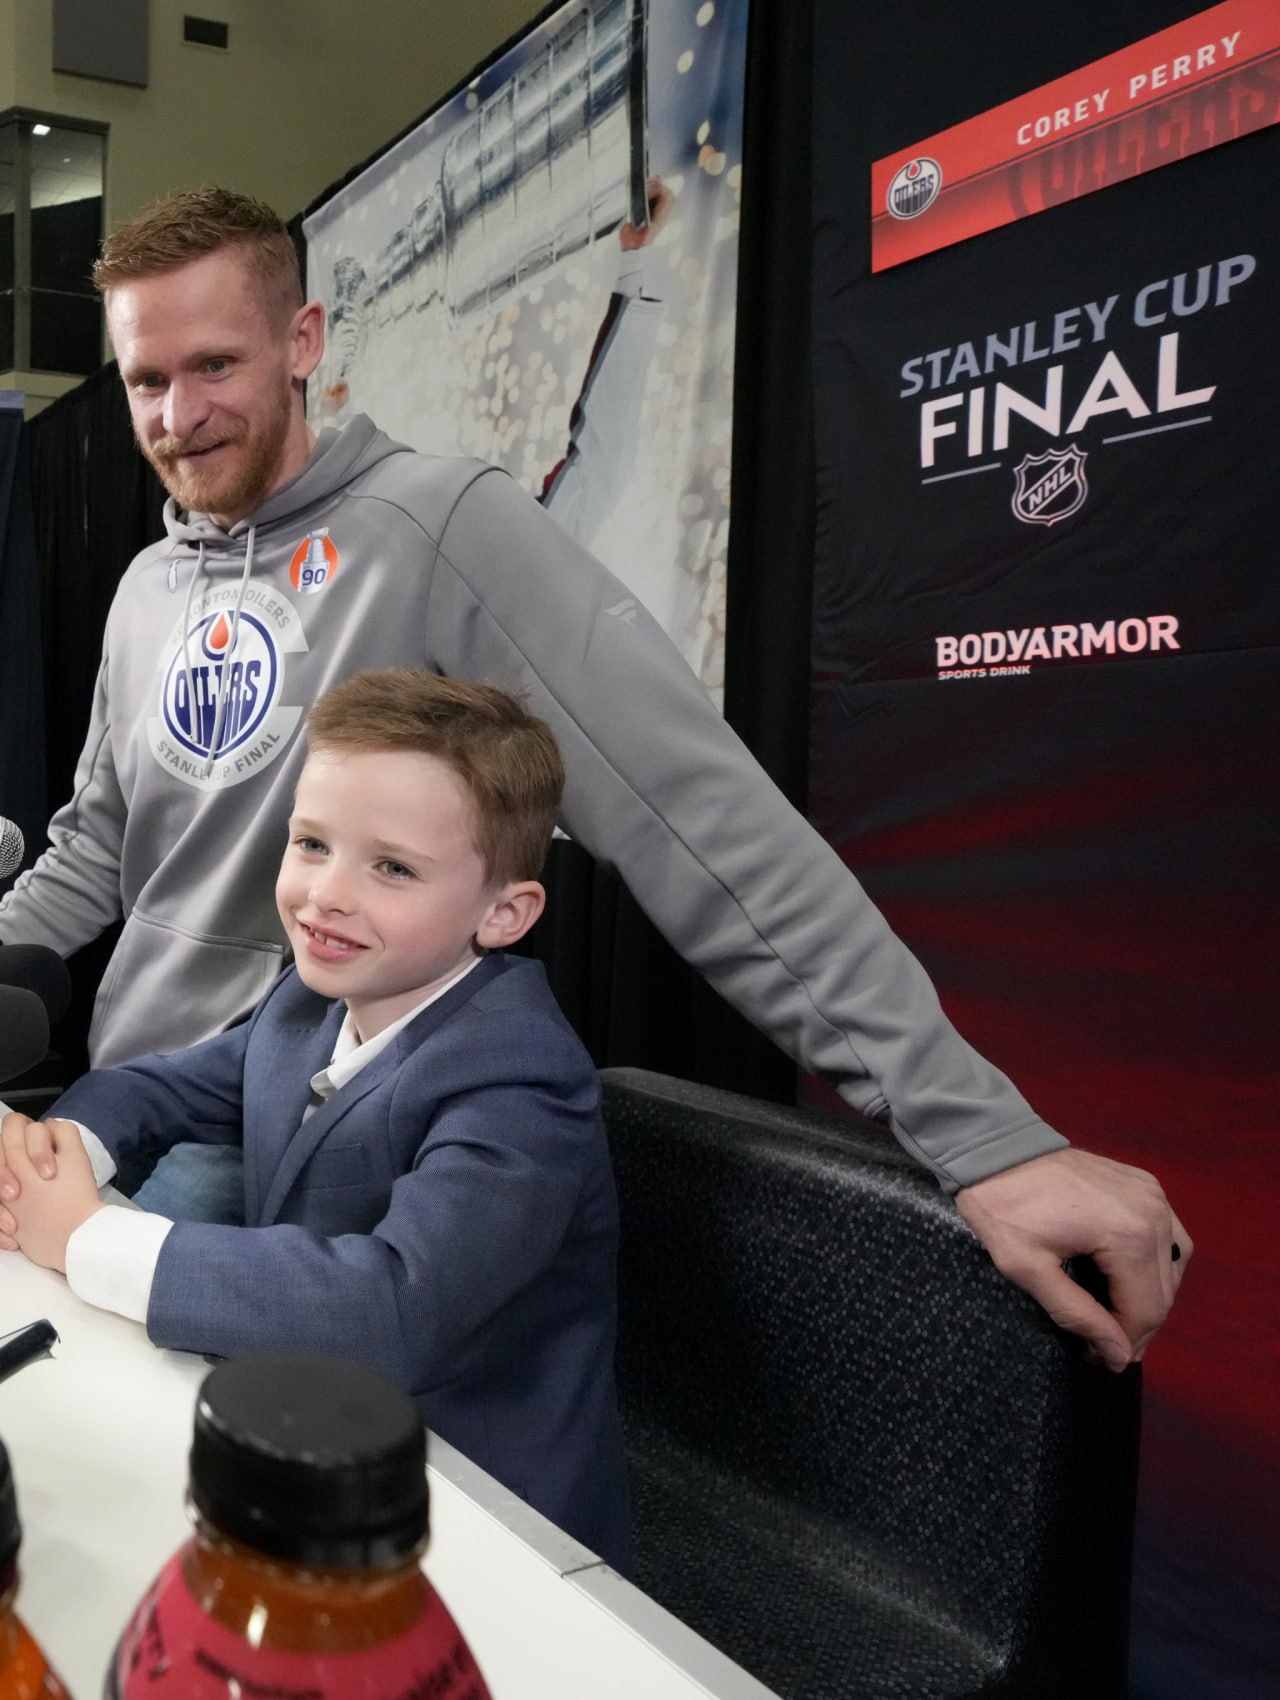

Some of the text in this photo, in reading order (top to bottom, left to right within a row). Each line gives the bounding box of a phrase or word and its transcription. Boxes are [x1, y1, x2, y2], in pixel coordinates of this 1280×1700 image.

[1017, 31, 1241, 146] COREY PERRY
[894, 173, 934, 214] OILERS
[900, 254, 1257, 398] STANLEY CUP
[920, 332, 1217, 468] FINAL
[1028, 468, 1073, 512] NHL
[301, 568, 327, 586] 90
[245, 590, 290, 630] OILERS
[935, 615, 1181, 667] BODYARMOR
[938, 664, 1031, 681] SPORTS DRINK
[234, 733, 280, 773] FINAL
